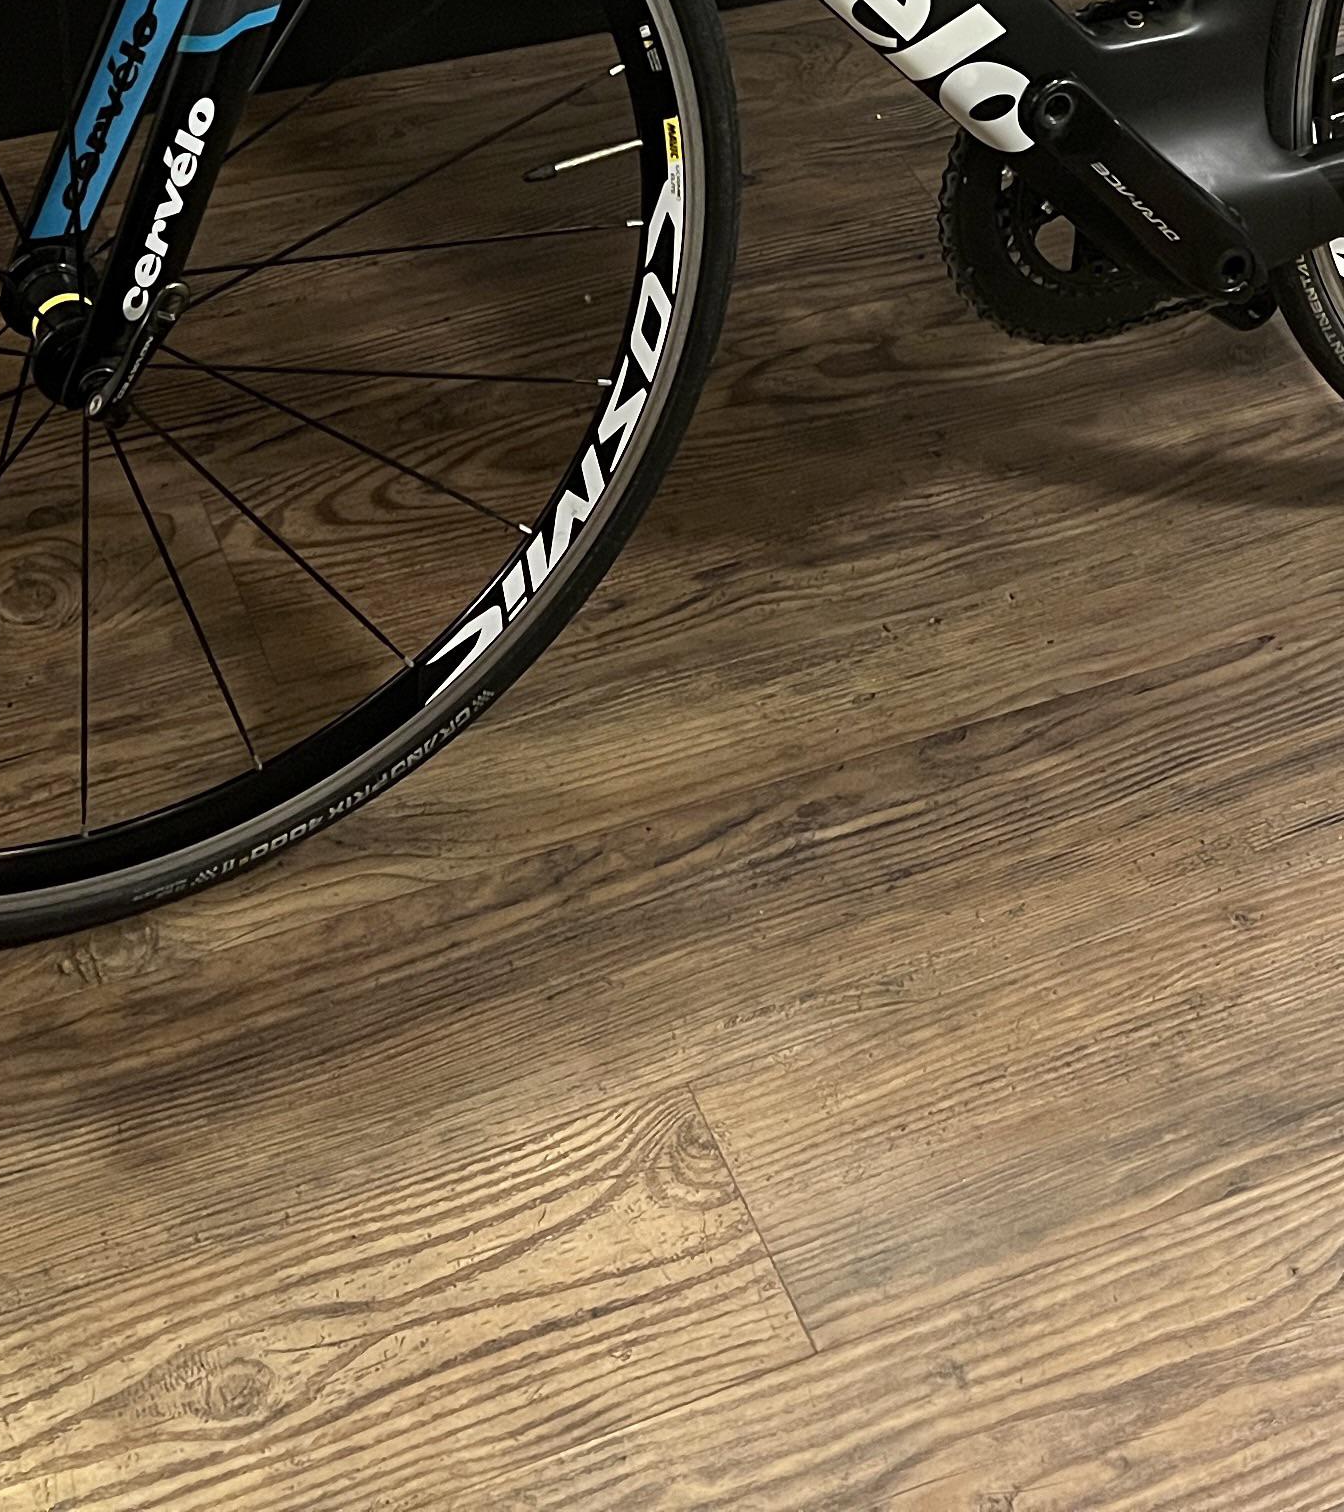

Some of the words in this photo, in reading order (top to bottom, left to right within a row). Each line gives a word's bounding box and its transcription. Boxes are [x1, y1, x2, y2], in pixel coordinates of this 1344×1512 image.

[61, 11, 159, 211] cervélo
[122, 96, 216, 324] cervélo
[1090, 160, 1181, 242] DURA-ACE
[390, 706, 472, 779] GRAND
[327, 773, 391, 820] PRIX
